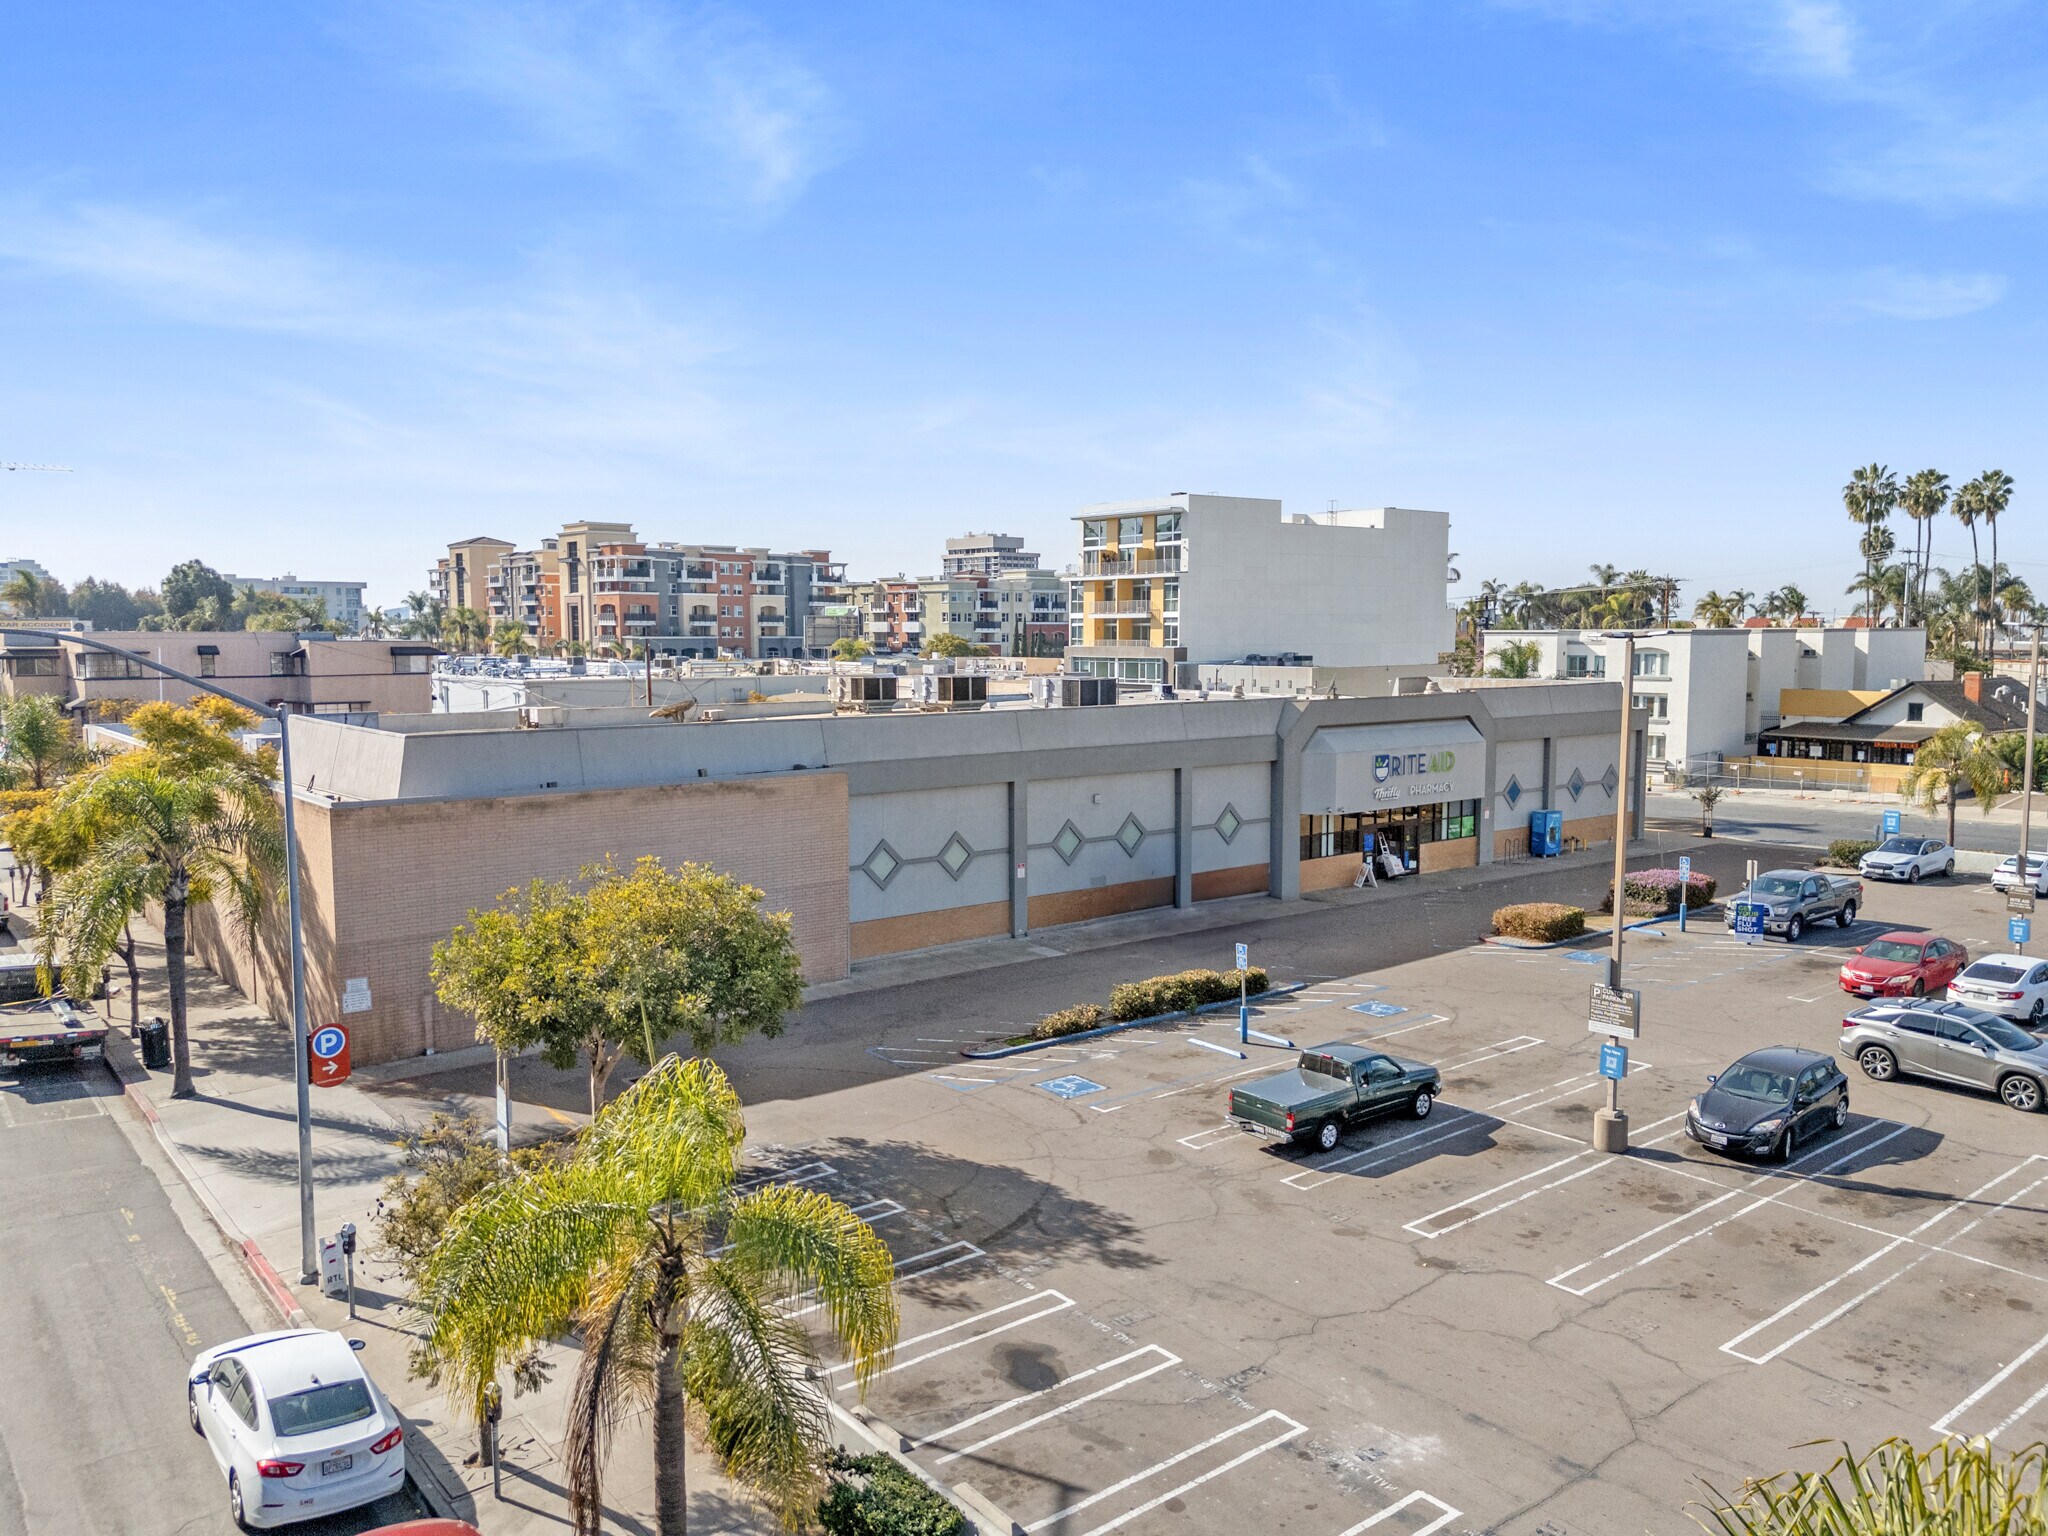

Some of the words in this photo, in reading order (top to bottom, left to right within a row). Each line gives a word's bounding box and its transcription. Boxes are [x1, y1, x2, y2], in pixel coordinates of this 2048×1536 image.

[1391, 754, 1427, 776] RITE
[1428, 751, 1456, 774] AID
[1374, 786, 1401, 800] Thrifty
[1410, 782, 1455, 796] PHARMACY
[1602, 994, 1626, 1003] PARKING
[1603, 988, 1634, 999] CUSTOMER
[320, 1034, 337, 1054] P
[327, 1273, 344, 1284] RTL
